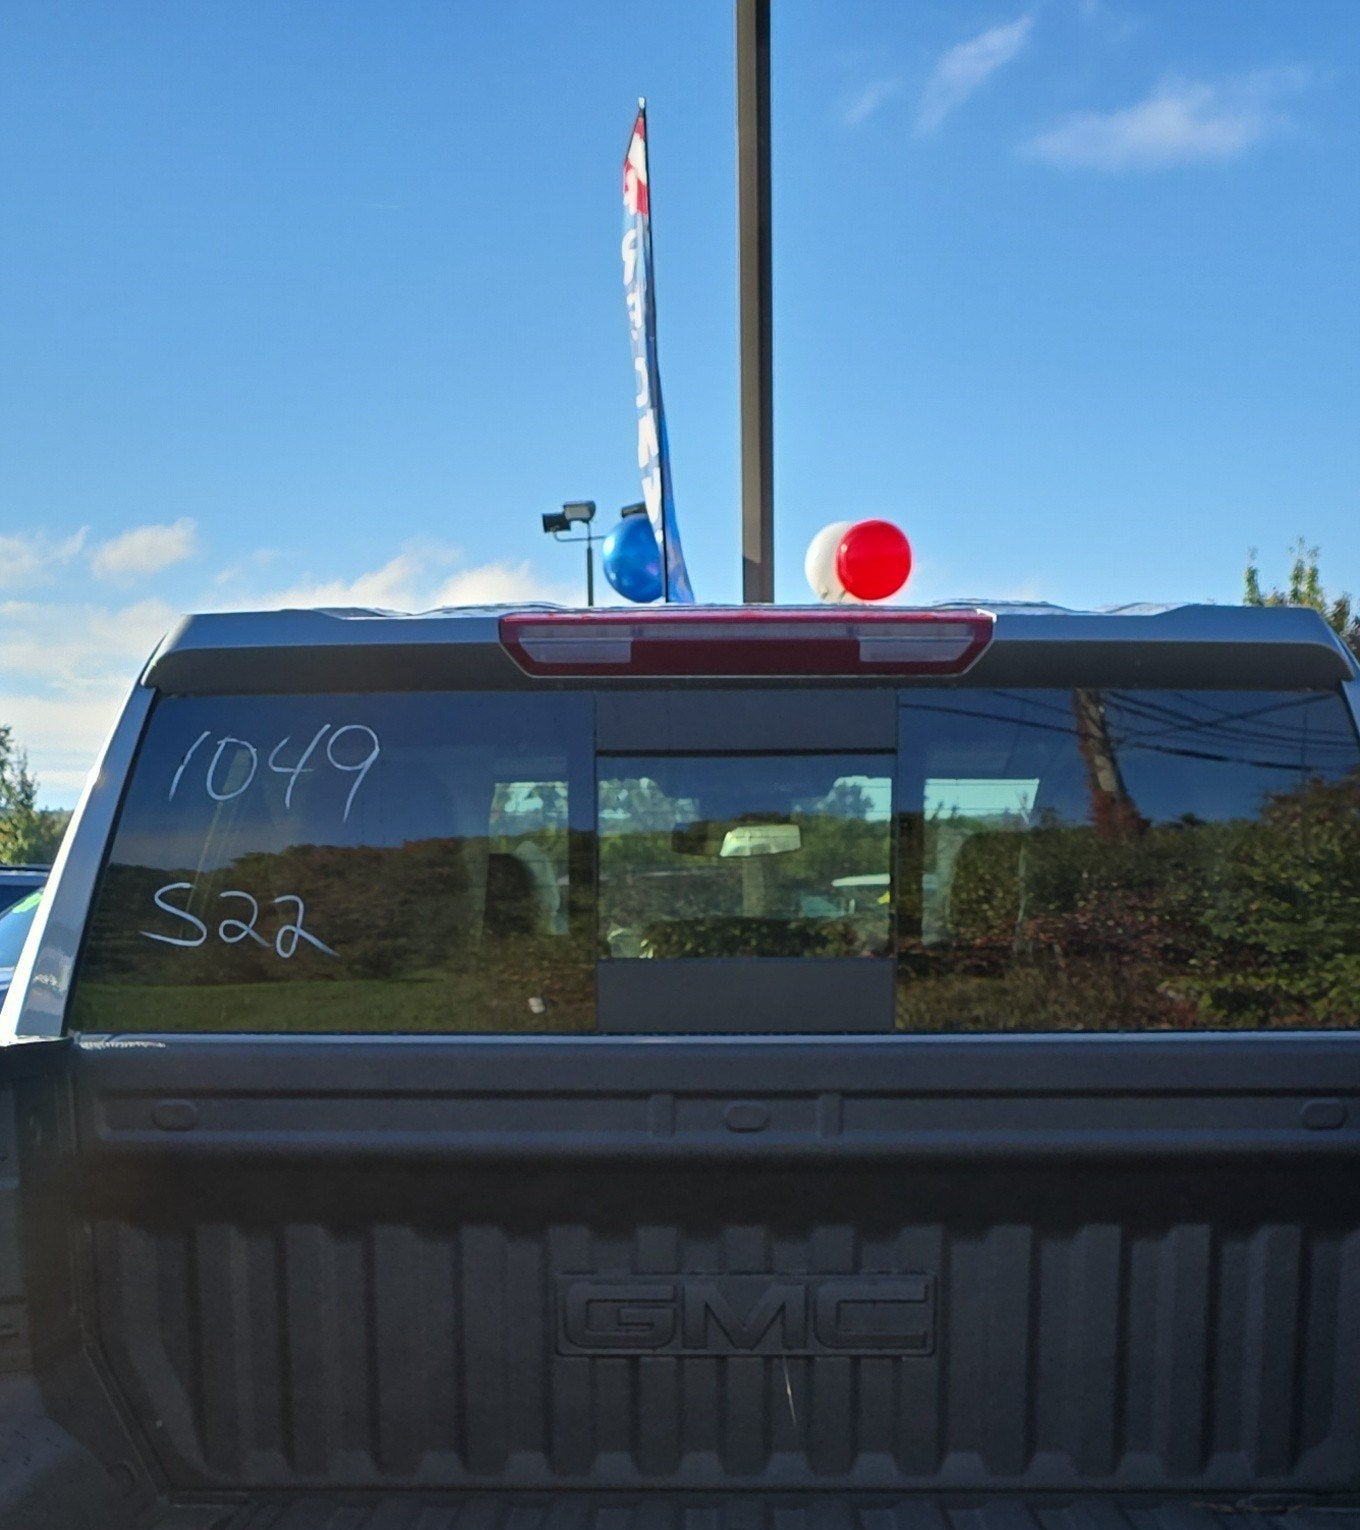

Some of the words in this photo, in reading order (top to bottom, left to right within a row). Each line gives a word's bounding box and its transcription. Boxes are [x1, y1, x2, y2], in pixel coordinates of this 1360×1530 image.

[169, 724, 381, 823] 1049
[141, 882, 339, 959] S22
[564, 1281, 928, 1350] GMC
